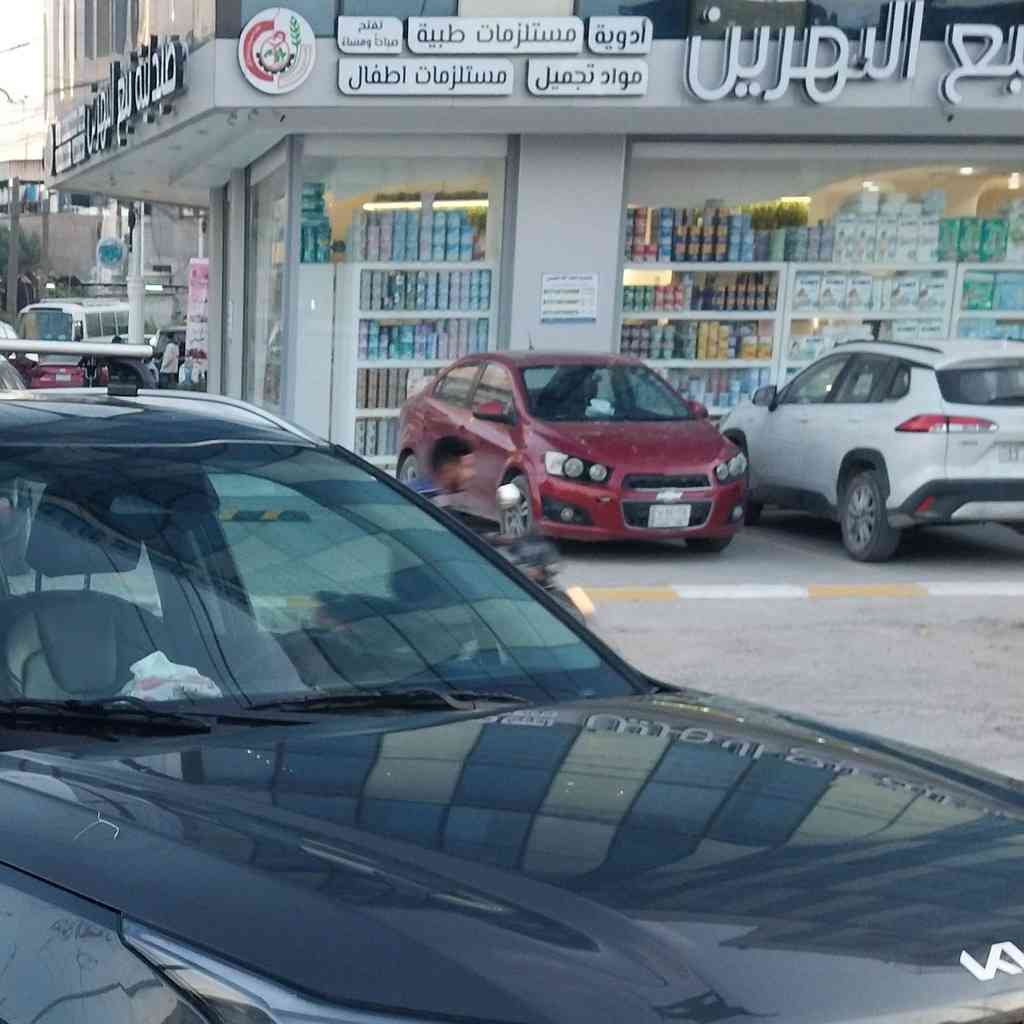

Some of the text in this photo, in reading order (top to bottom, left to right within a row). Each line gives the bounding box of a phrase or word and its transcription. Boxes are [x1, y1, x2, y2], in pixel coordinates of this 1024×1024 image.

[416, 21, 577, 49] مستلزمات طبية
[594, 17, 648, 50] أدوية
[684, 0, 924, 104] النهرين
[348, 63, 508, 90] مستلزمات اطفال
[534, 63, 643, 91] مواد تجميل
